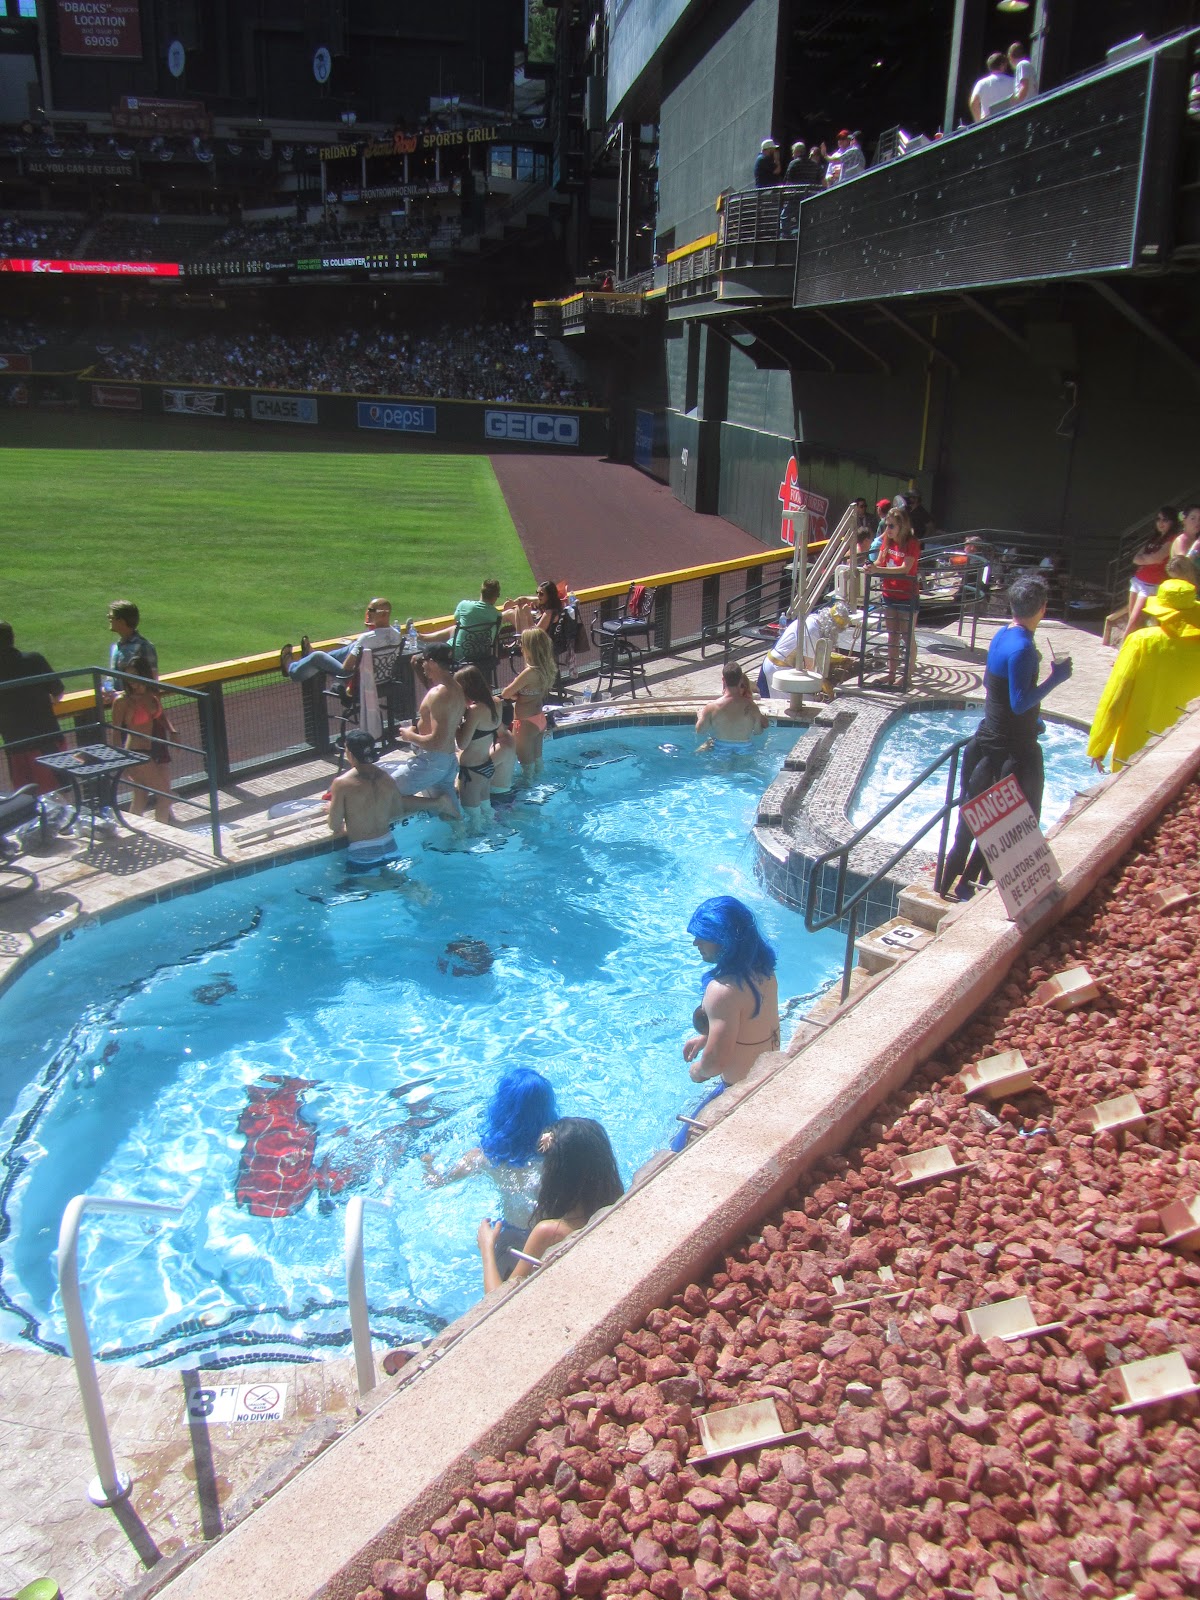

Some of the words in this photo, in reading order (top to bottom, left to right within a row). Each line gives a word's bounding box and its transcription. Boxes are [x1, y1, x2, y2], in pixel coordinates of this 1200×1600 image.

[74, 15, 126, 27] LOCATION
[85, 36, 119, 47] 69050
[319, 145, 358, 161] FRIDAY'S
[422, 130, 464, 149] SPORTS
[466, 127, 498, 143] GRILL
[104, 166, 132, 175] SEATS
[69, 263, 111, 273] University
[111, 264, 121, 272] of
[122, 265, 156, 273] Phoenix
[323, 259, 330, 267] 55
[256, 400, 298, 417] CHASE
[383, 407, 424, 428] pepsi
[486, 411, 579, 443] GEICO
[963, 780, 1024, 834] DANGER
[984, 843, 998, 864] NO
[999, 815, 1038, 855] JUMPING
[999, 856, 1036, 891] VIOLATORS
[1035, 843, 1051, 864] WILL
[1012, 884, 1023, 901] BE
[1022, 862, 1051, 895] EJECTED
[220, 1387, 237, 1397] FT
[190, 1389, 217, 1417] 3
[236, 1414, 249, 1422] NO
[250, 1412, 280, 1421] DIVING
